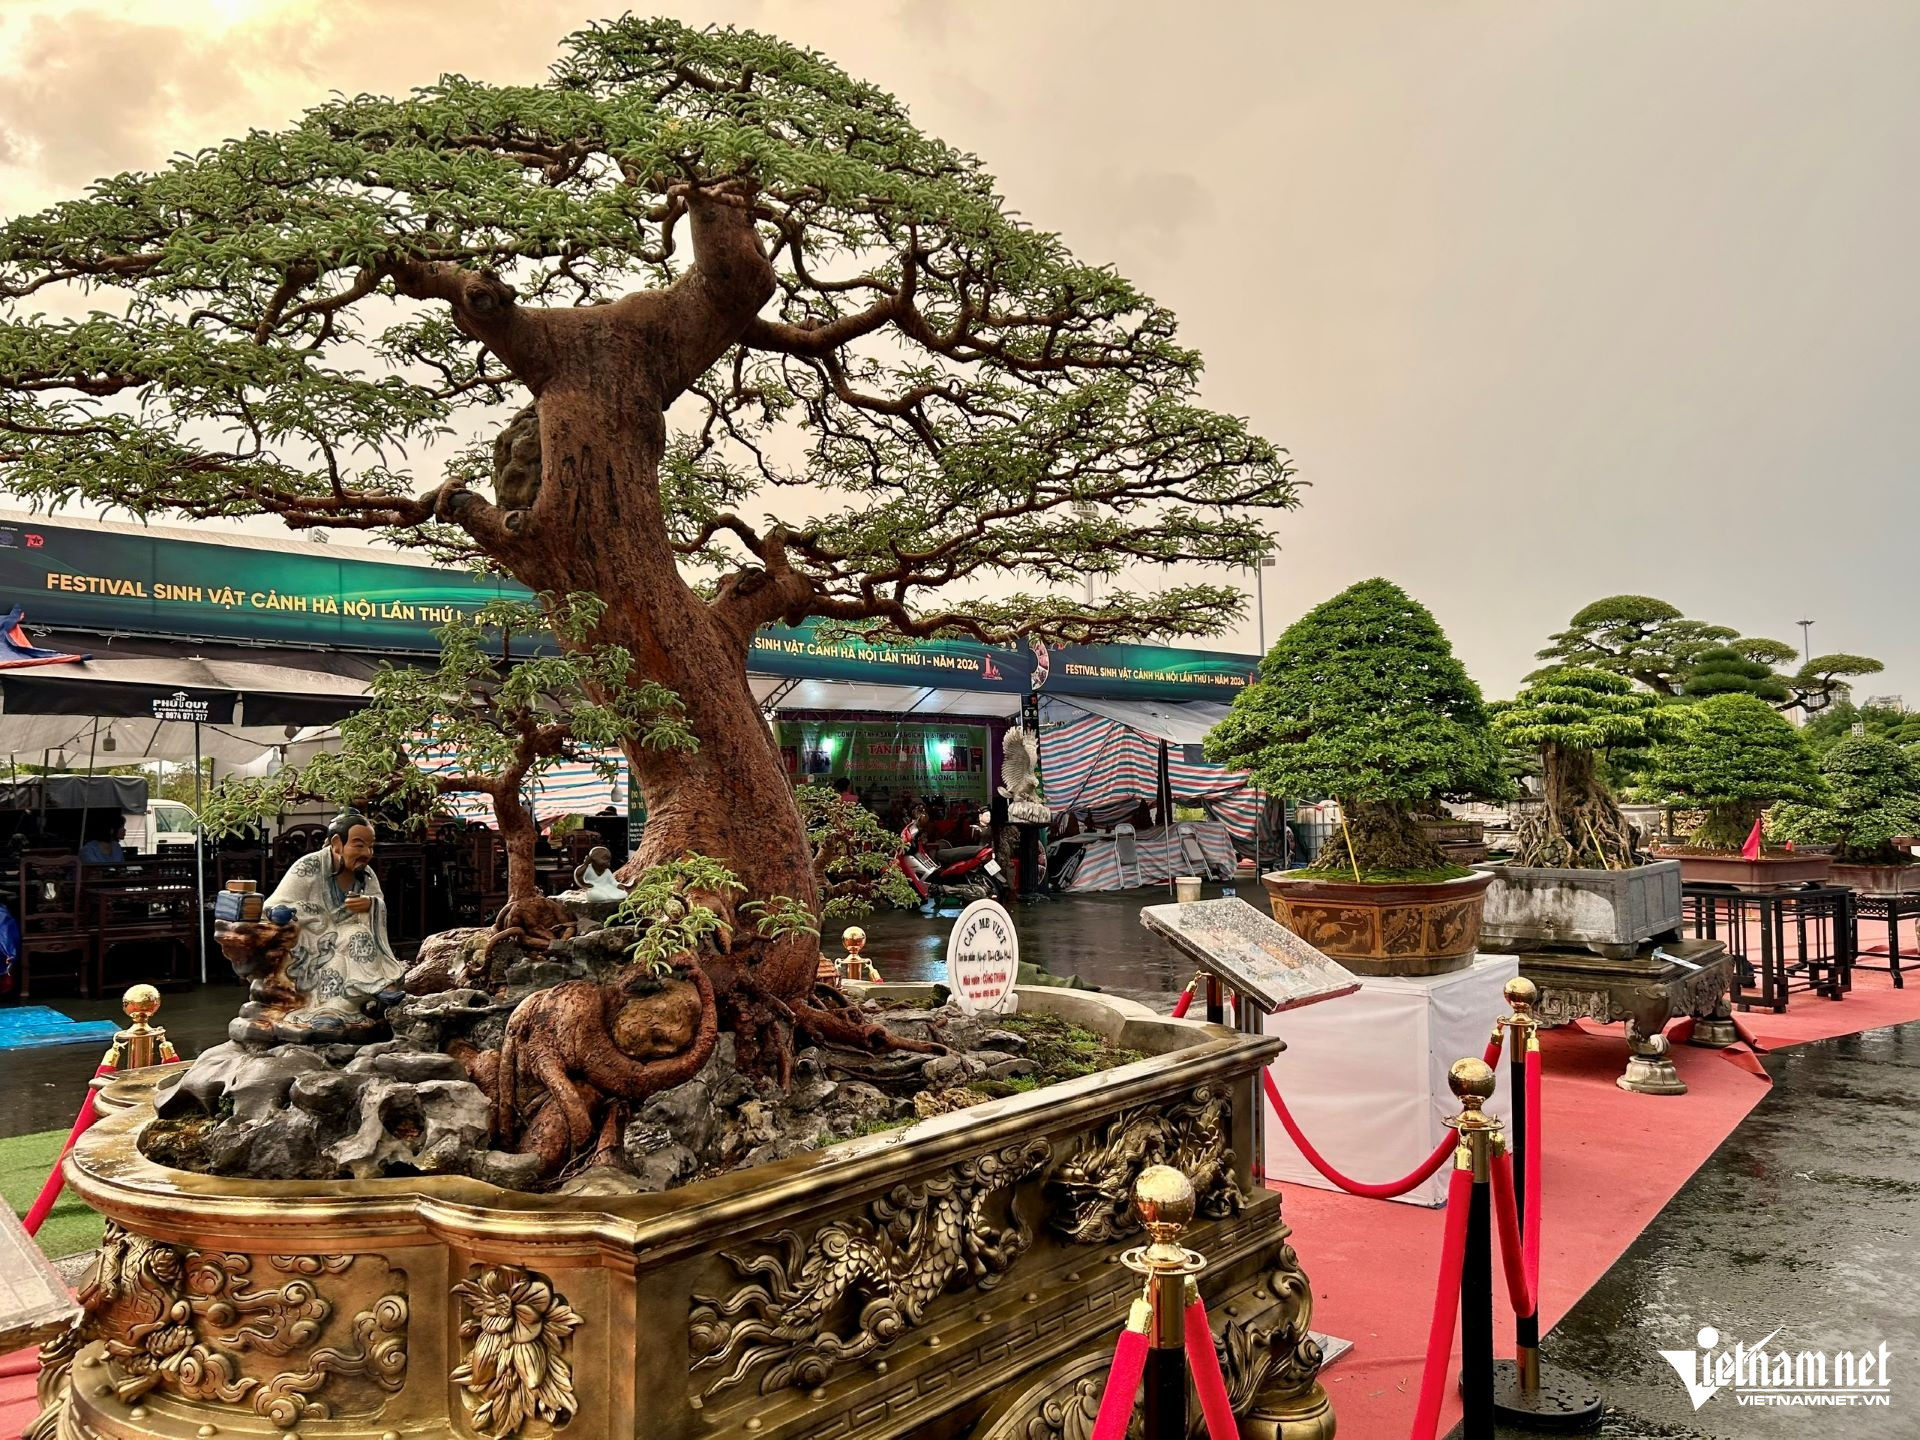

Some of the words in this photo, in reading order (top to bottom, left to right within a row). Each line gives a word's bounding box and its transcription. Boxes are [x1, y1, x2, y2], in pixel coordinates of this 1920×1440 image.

[47, 573, 147, 598] FESTIVAL
[153, 583, 202, 602] SINH
[208, 586, 246, 610] VẬT
[251, 589, 307, 612] CẢNH
[312, 595, 339, 615] HÀ
[343, 598, 376, 620] NỘI
[381, 600, 415, 620] LẦN
[418, 605, 455, 623] THỨ
[754, 637, 781, 651] SINH
[784, 639, 805, 656] VẬT
[840, 644, 856, 659] HÀ
[858, 647, 877, 664] NỘI
[901, 652, 921, 665] THỨ
[933, 654, 955, 668] NĂM
[956, 658, 979, 671] 2024
[1065, 663, 1099, 676] FESTIVAL
[1100, 667, 1117, 677] SINH
[1118, 667, 1131, 680] VẬT
[1133, 668, 1154, 680] CẢNH
[1215, 674, 1229, 685] NĂM
[1230, 676, 1245, 686] 2024
[196, 713, 208, 721] 217
[979, 917, 990, 930] ME
